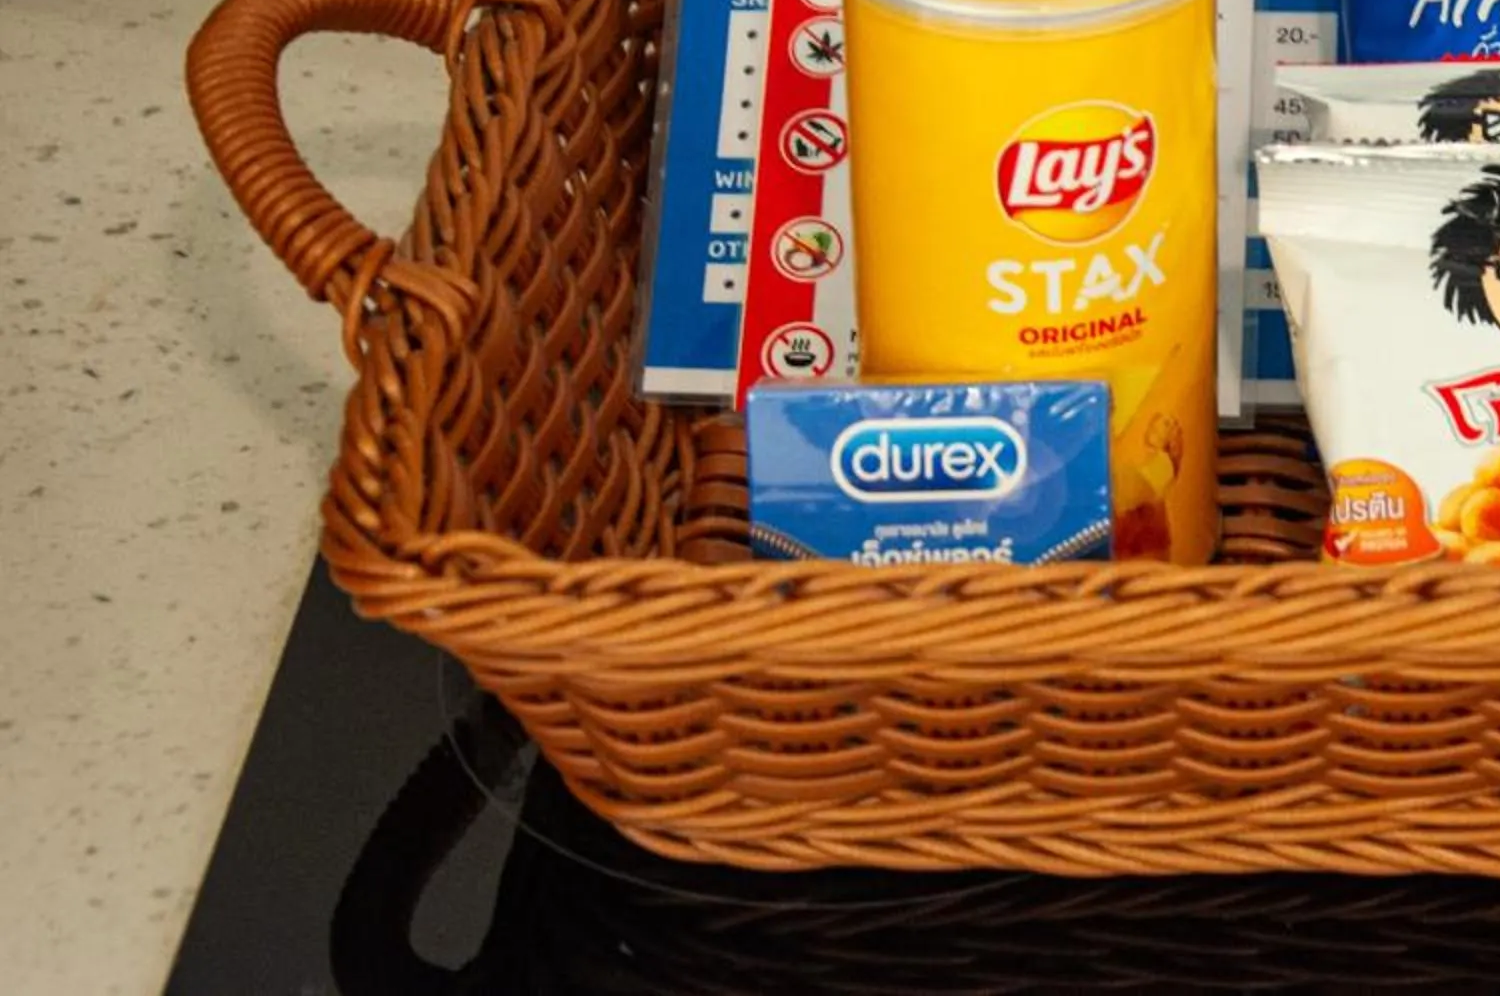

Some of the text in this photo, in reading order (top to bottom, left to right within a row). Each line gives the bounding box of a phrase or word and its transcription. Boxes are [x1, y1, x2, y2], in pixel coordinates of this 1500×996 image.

[1007, 126, 1150, 214] Lay's
[985, 232, 1167, 315] STAX
[1018, 307, 1148, 346] ORIGINAL
[851, 432, 1005, 482] durex
